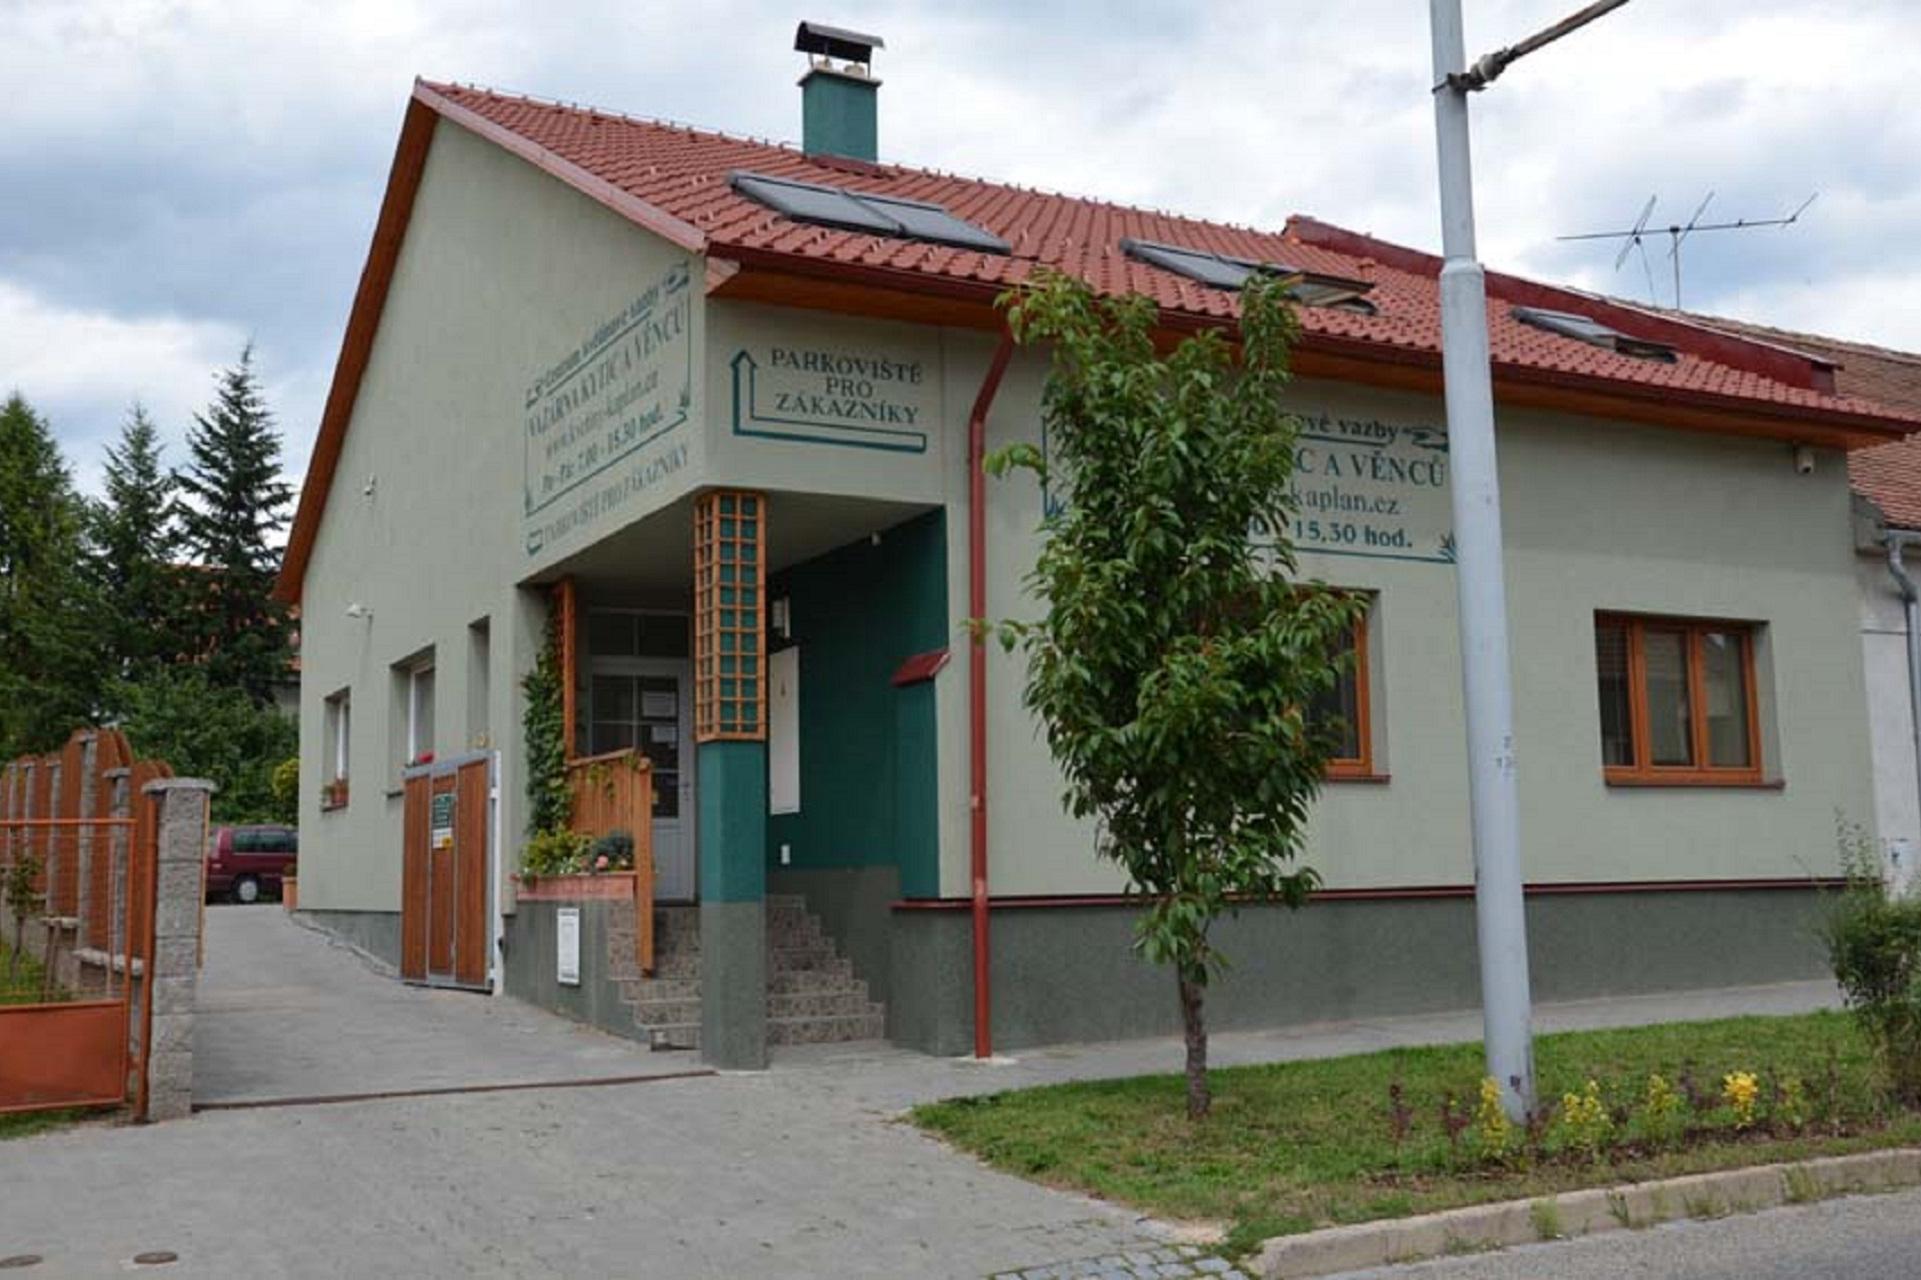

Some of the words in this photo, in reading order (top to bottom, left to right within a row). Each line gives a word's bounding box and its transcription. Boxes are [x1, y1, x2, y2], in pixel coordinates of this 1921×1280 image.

[635, 300, 684, 360] VĚNCŮ
[771, 347, 923, 384] PARKOVIŠTĚ
[826, 377, 873, 398] PRO
[775, 389, 920, 425] ZÁKAZNÍKY
[1338, 420, 1398, 445] vazby
[1324, 454, 1342, 476] A
[1350, 450, 1445, 487] VĚNCŮ
[1290, 481, 1399, 515] kaplan.cz
[1296, 520, 1357, 543] 15.30
[1364, 524, 1414, 548] hod.
